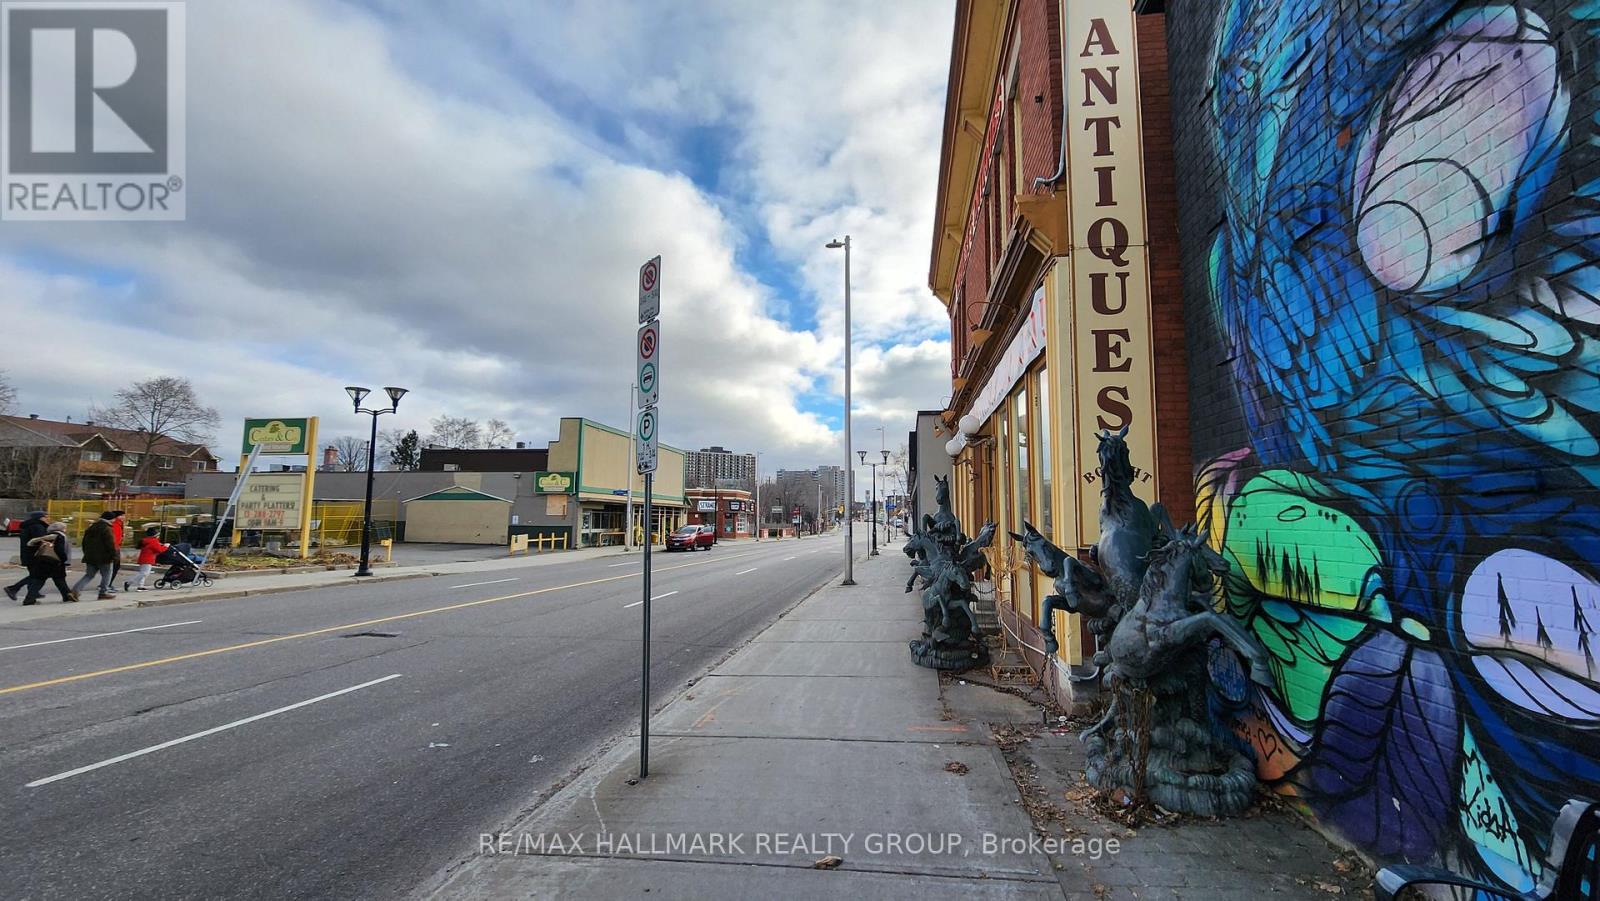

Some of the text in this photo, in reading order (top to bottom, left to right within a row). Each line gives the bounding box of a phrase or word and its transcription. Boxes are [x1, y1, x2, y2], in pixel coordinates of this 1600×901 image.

[1079, 17, 1134, 432] ANTIQUES
[250, 484, 280, 492] CATERING
[241, 501, 260, 509] PARTY
